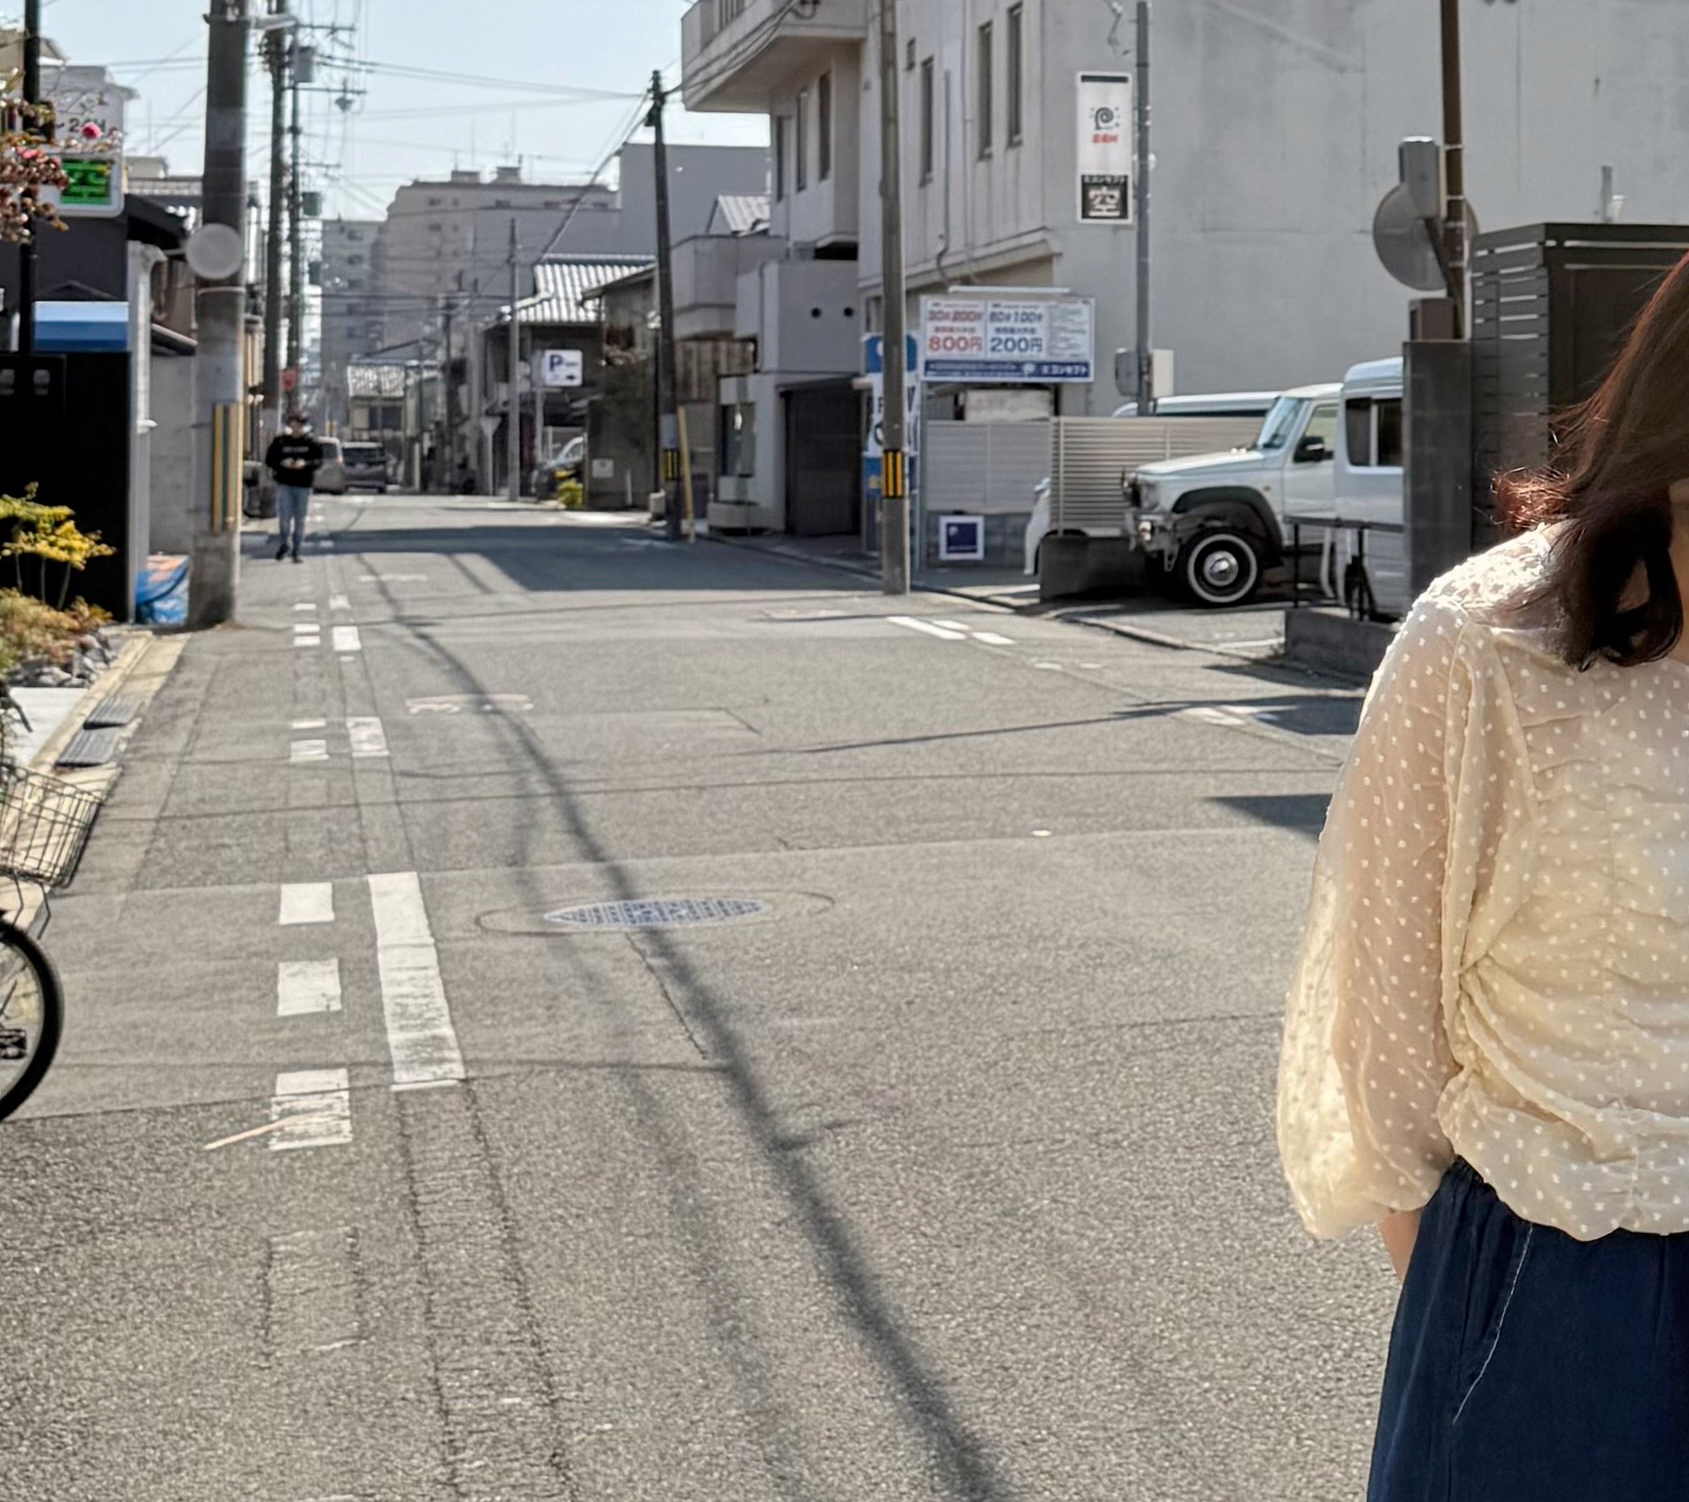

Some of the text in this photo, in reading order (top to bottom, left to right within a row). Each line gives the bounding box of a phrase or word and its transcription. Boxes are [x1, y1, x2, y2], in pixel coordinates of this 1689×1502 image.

[1088, 185, 1121, 217] 空
[928, 335, 983, 352] 800円
[989, 336, 1043, 353] 200円
[550, 354, 563, 372] P
